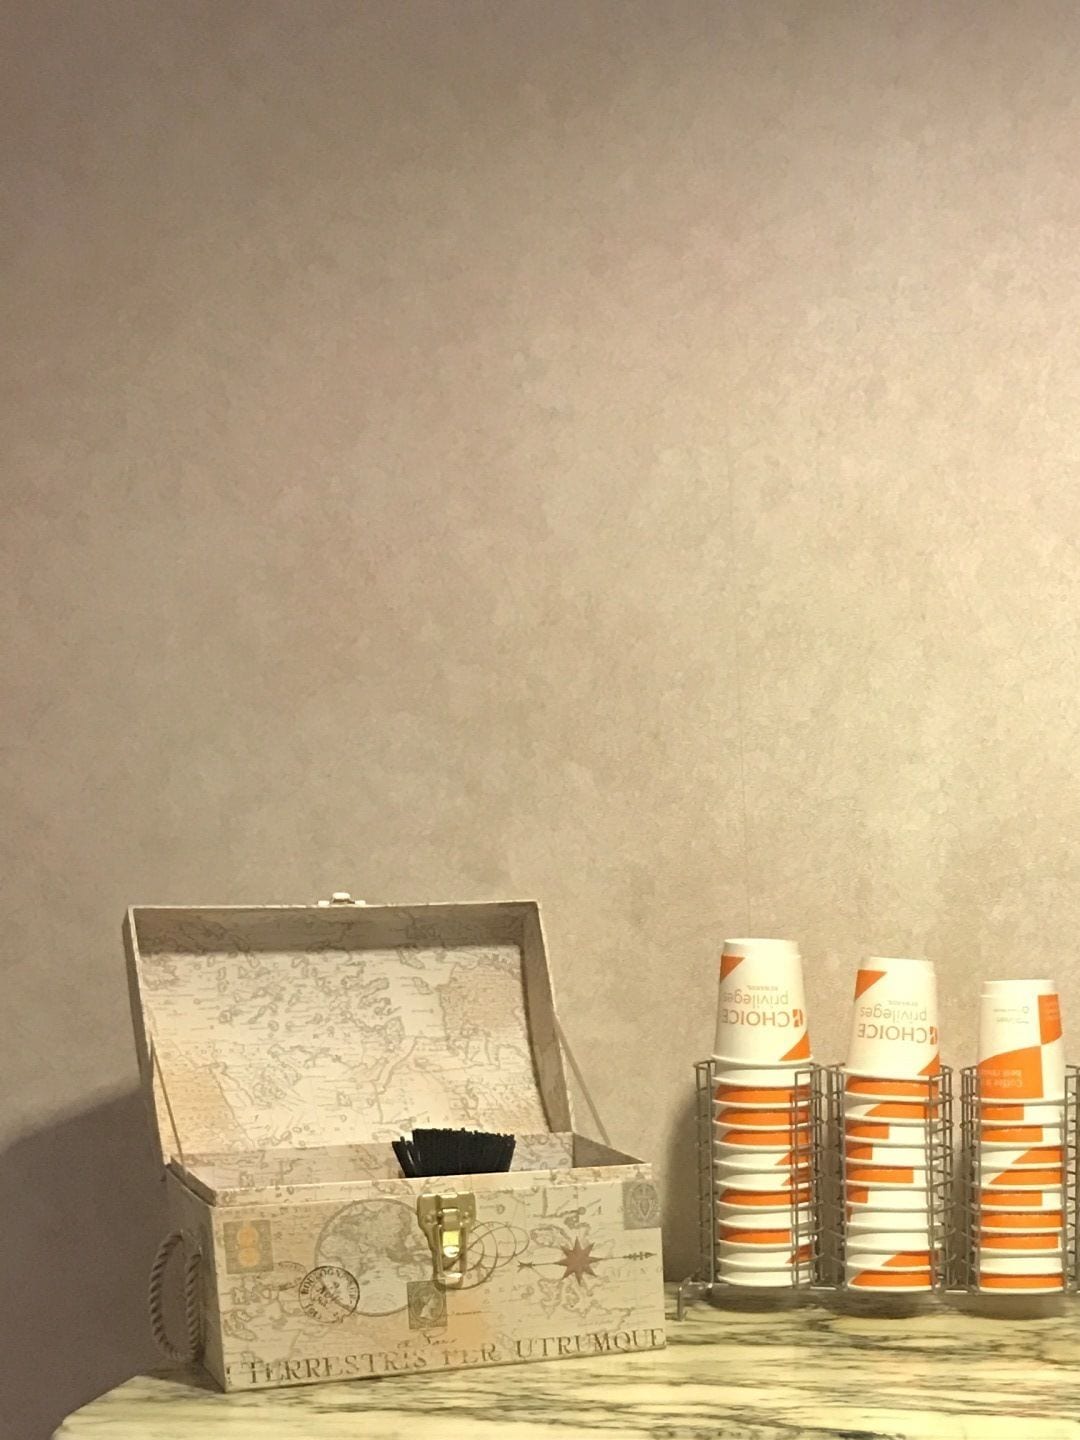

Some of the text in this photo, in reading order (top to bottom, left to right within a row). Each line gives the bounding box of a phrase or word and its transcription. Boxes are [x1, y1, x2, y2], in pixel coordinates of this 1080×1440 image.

[723, 988, 789, 1009] privileges
[721, 1008, 791, 1028] CHOICE
[860, 1003, 927, 1024] privileges
[857, 1023, 928, 1044] CHOICE
[243, 1349, 428, 1384] TERRESTRIS
[514, 1327, 666, 1359] UTRUMQUE
